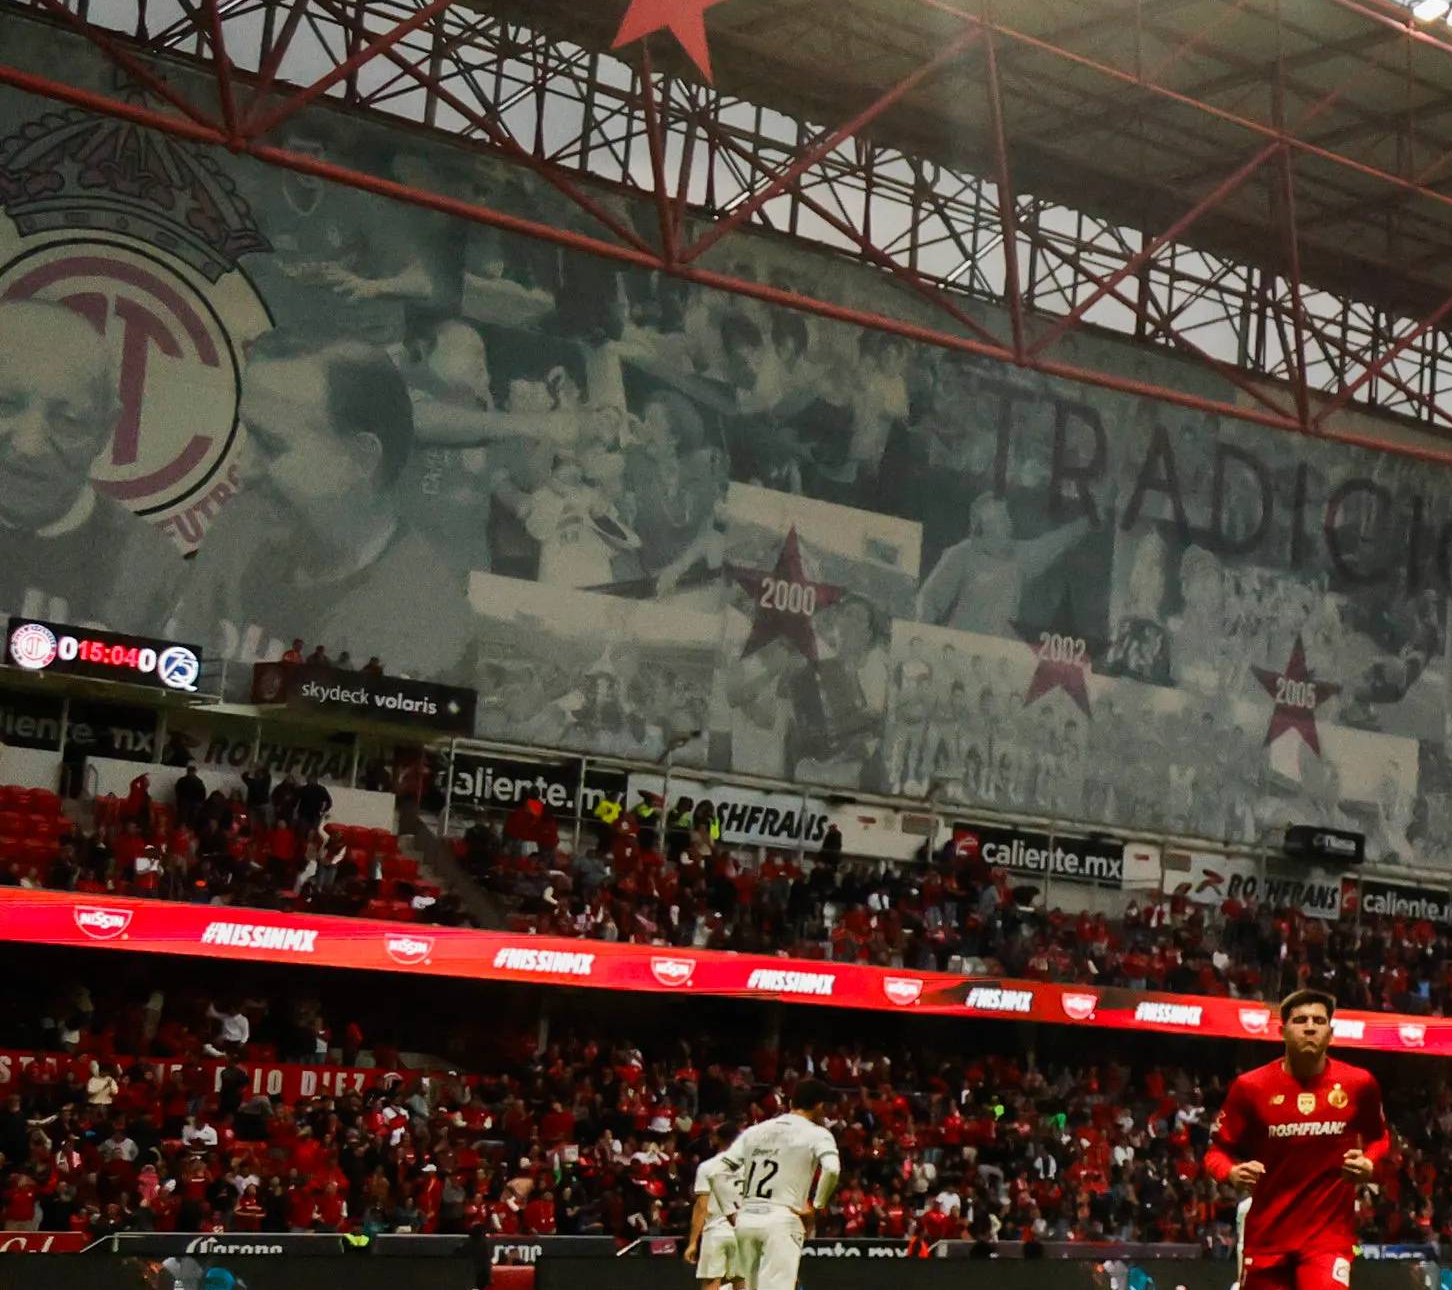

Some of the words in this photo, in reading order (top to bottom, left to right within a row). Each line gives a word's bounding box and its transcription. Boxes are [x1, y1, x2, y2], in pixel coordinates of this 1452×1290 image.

[760, 577, 817, 616] 2000
[58, 636, 78, 661] 0
[78, 640, 139, 667] 15:04
[139, 647, 157, 673] 0
[1039, 631, 1087, 665] 2002
[301, 681, 369, 704] skydeck
[374, 692, 438, 715] volaris
[1276, 676, 1316, 708] 2005
[981, 839, 1122, 879] caliente.mx
[80, 911, 125, 929] NISSIN
[200, 922, 319, 952] #NISSINMX
[492, 947, 596, 975] #NISSINMX
[745, 1159, 779, 1199] 12
